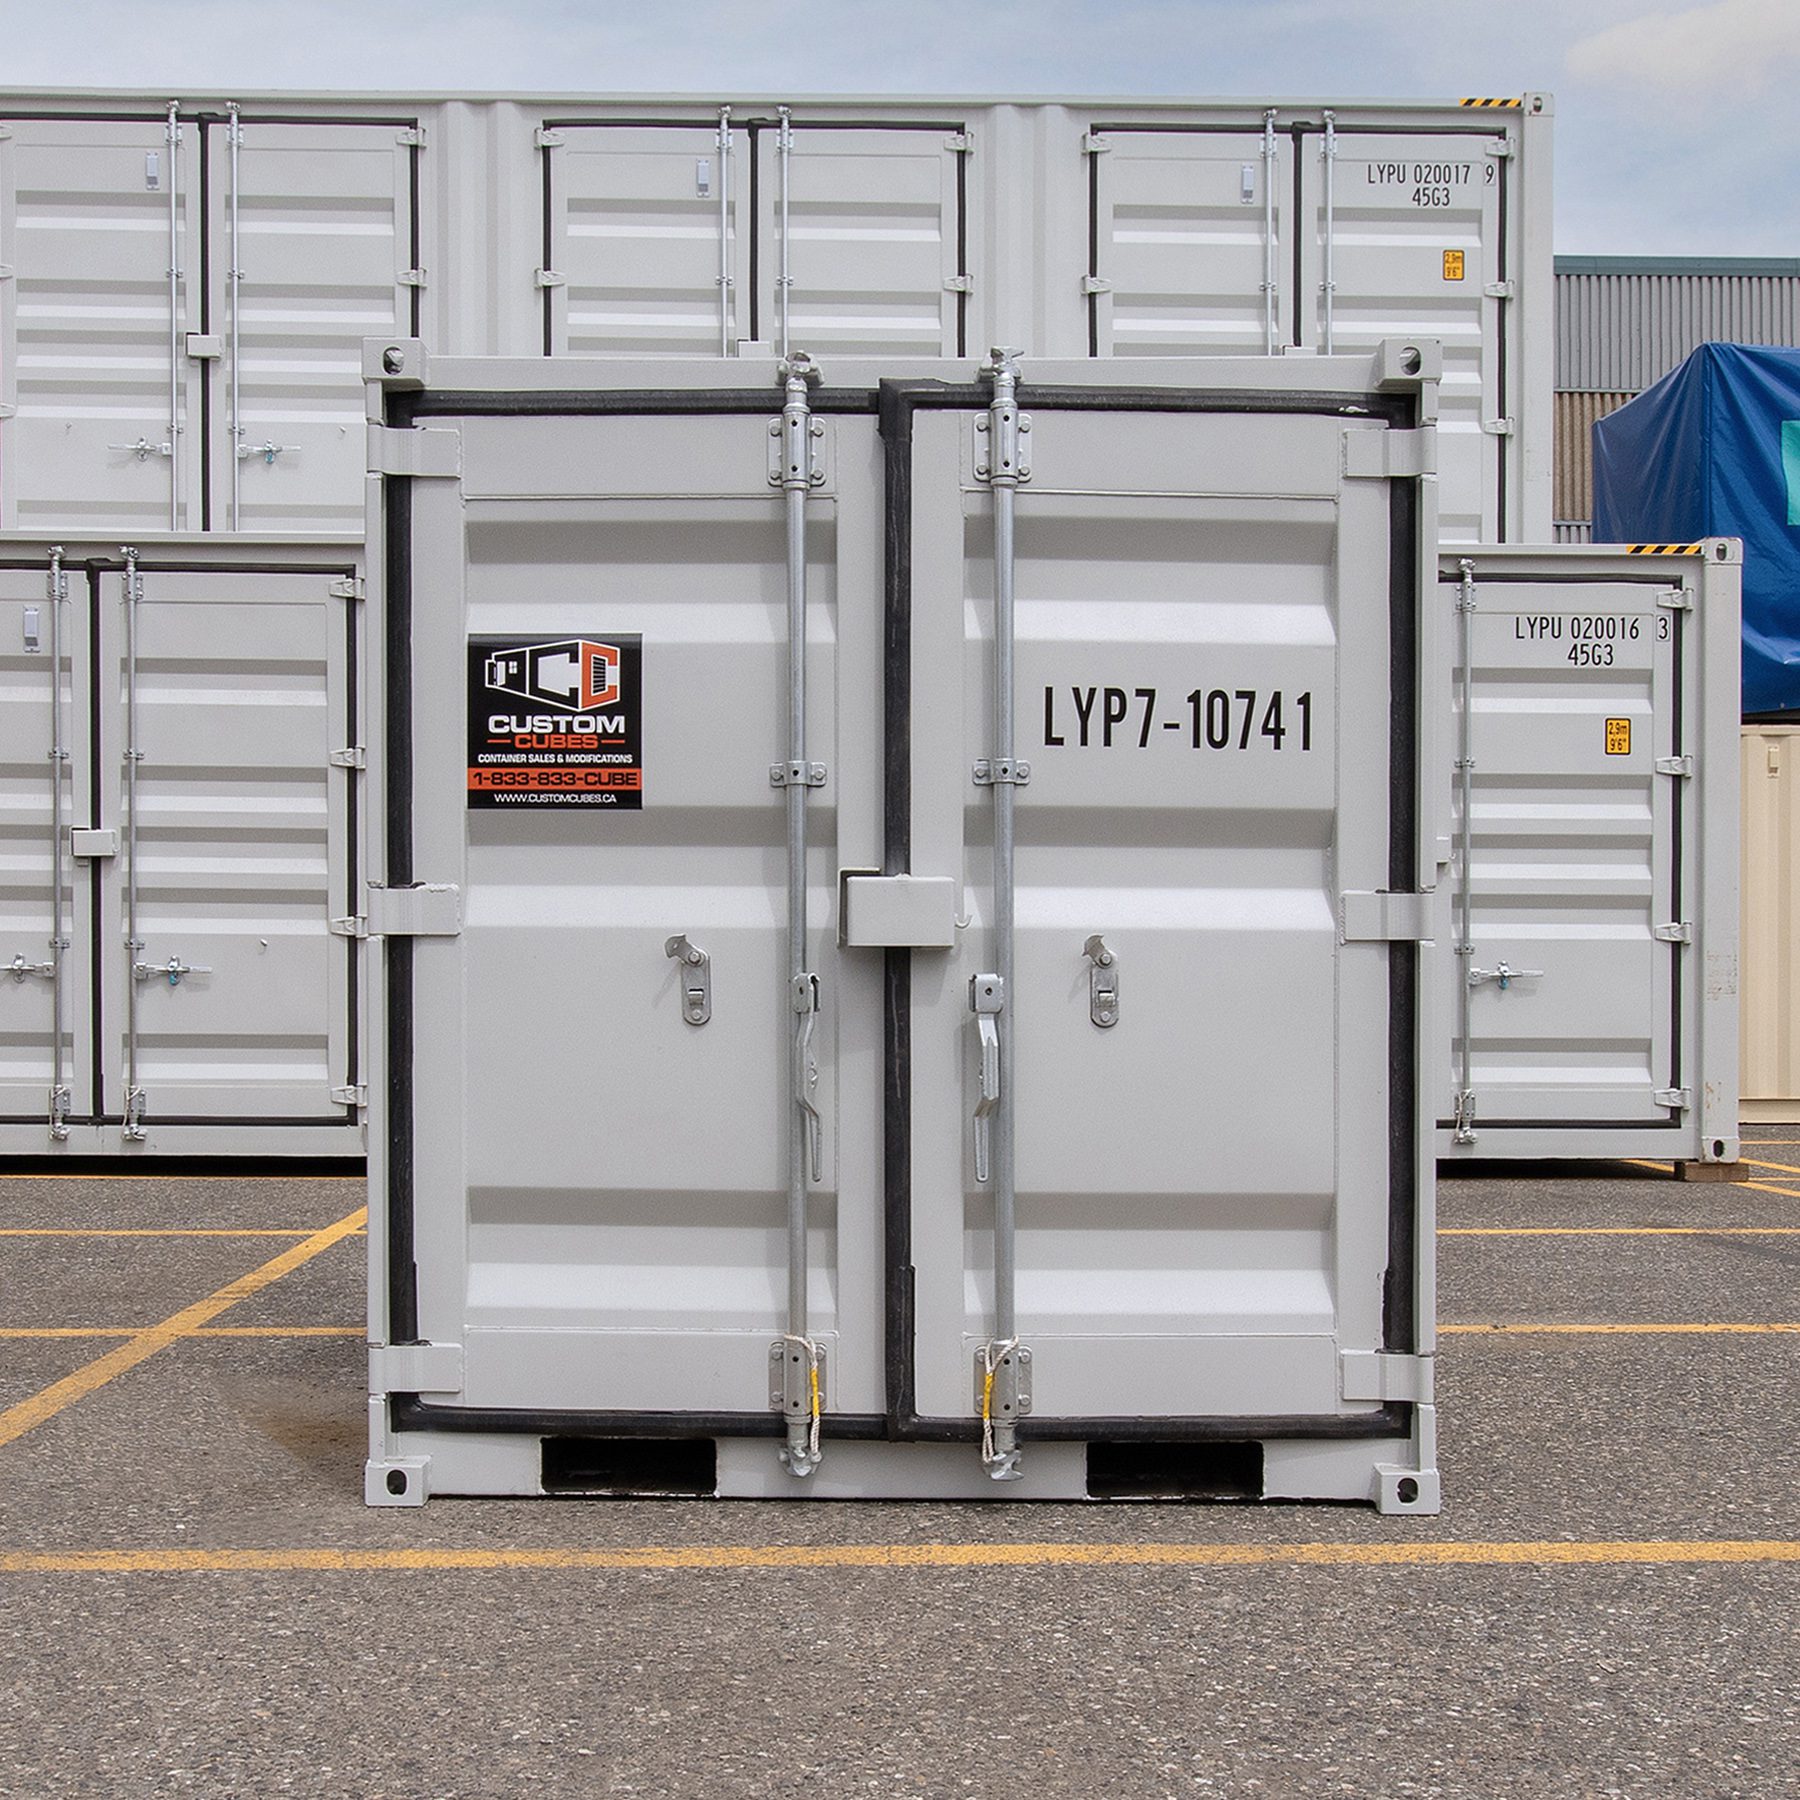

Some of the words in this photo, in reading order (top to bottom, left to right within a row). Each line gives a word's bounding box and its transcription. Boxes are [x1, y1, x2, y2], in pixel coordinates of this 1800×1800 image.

[1367, 164, 1406, 184] LYPU
[1414, 165, 1470, 184] 020017
[1485, 165, 1494, 184] 9
[1412, 187, 1450, 206] 45G3
[1515, 617, 1562, 639] LYPU
[1571, 617, 1640, 640] 020016
[1658, 617, 1668, 640] 3
[1568, 644, 1614, 666] 45G3
[488, 715, 625, 734] CUSTOM
[1044, 686, 1311, 751] LYP7-10741
[514, 734, 598, 749] CUBES
[478, 753, 527, 763] CONTAINER
[528, 753, 556, 763] SALES
[557, 753, 564, 763] &
[566, 753, 633, 763] MODIFICATIONS
[473, 772, 638, 786] 1-833-833-CUBE
[494, 793, 617, 804] WWW.CUSTOMCUBES.CA
